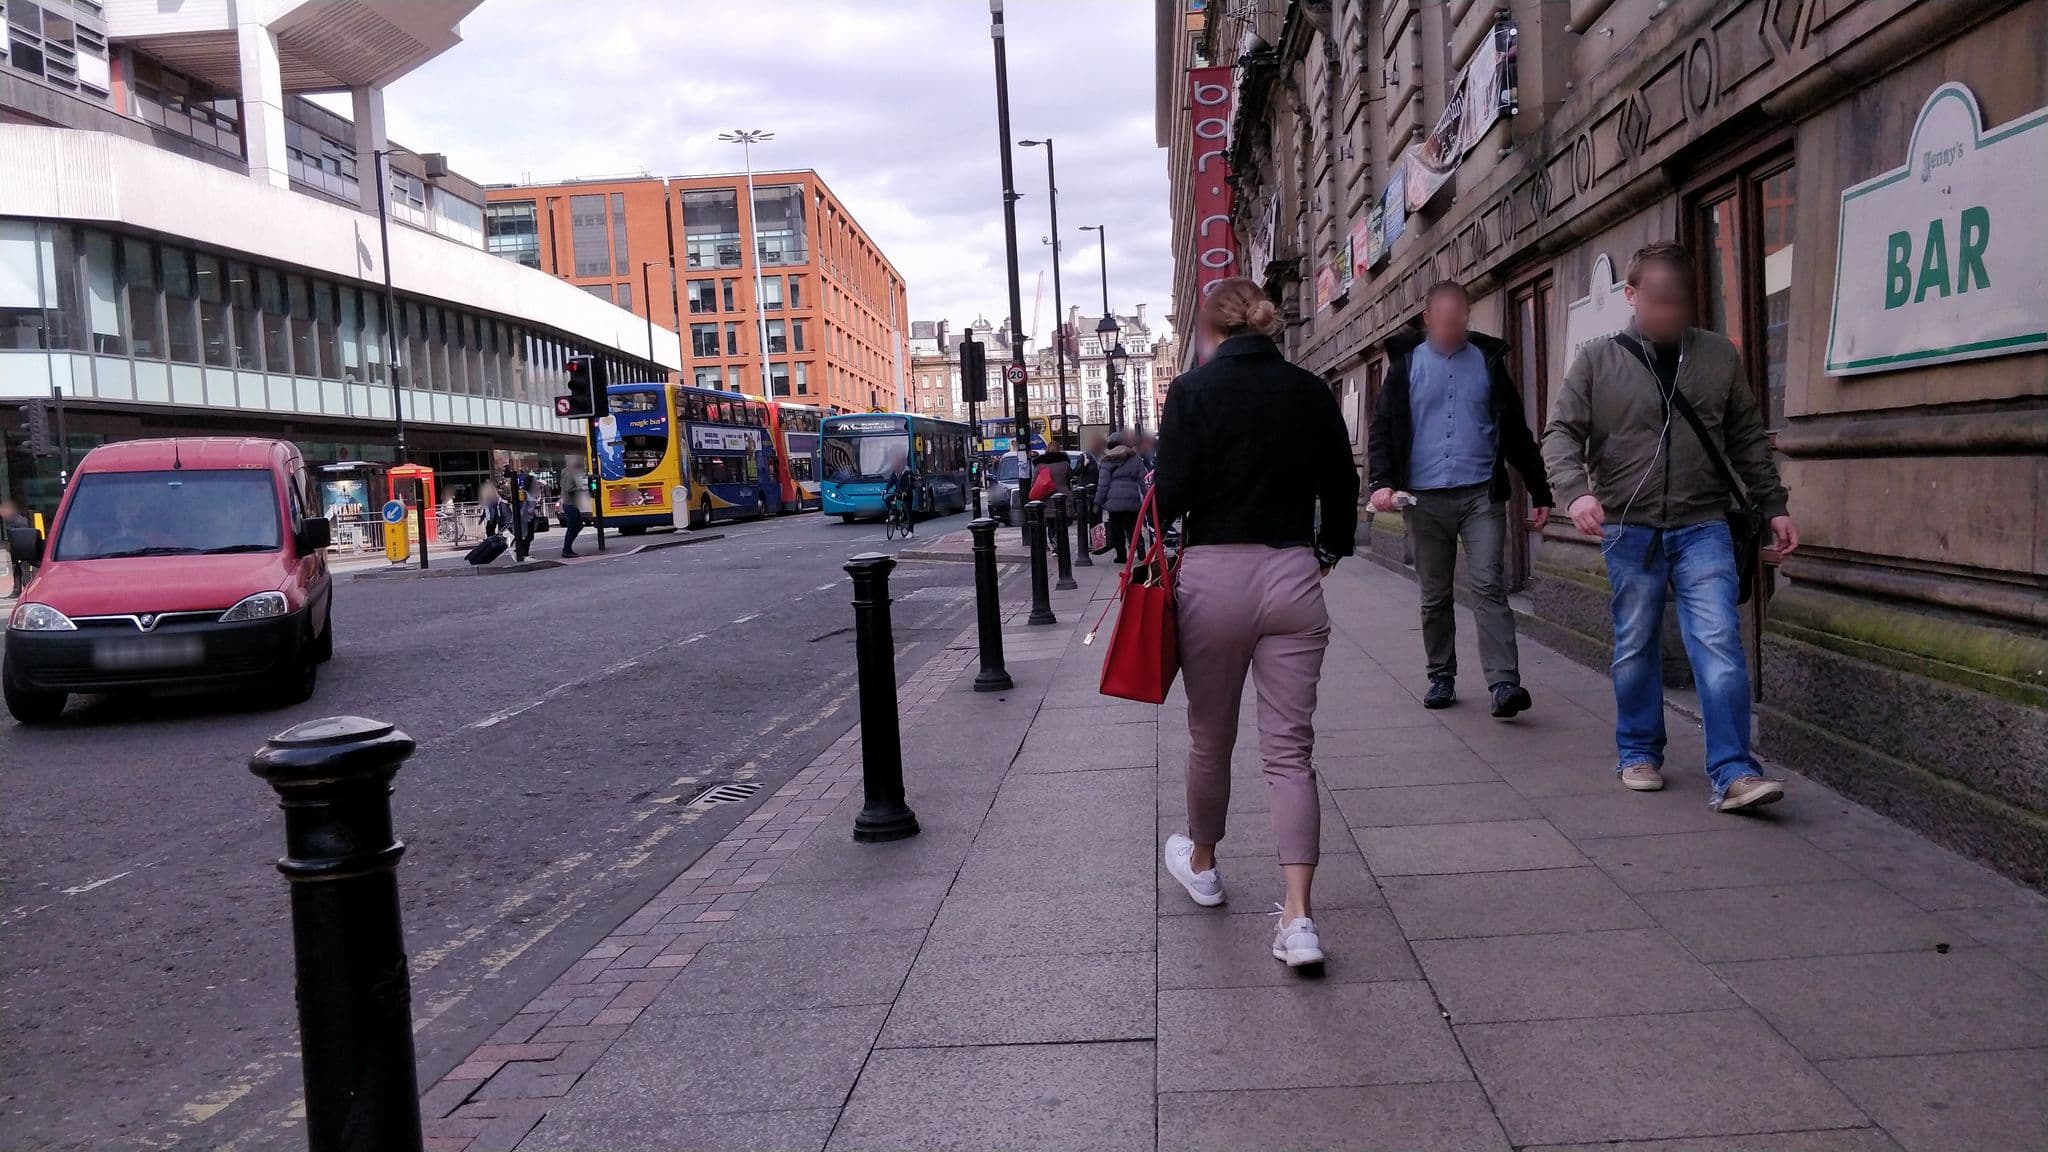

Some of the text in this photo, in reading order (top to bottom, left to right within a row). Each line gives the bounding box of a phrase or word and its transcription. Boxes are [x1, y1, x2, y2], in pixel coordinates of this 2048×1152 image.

[1920, 141, 1964, 184] Jenny's
[1885, 206, 1991, 310] BAR
[1010, 371, 1023, 380] 20
[629, 418, 649, 428] magic
